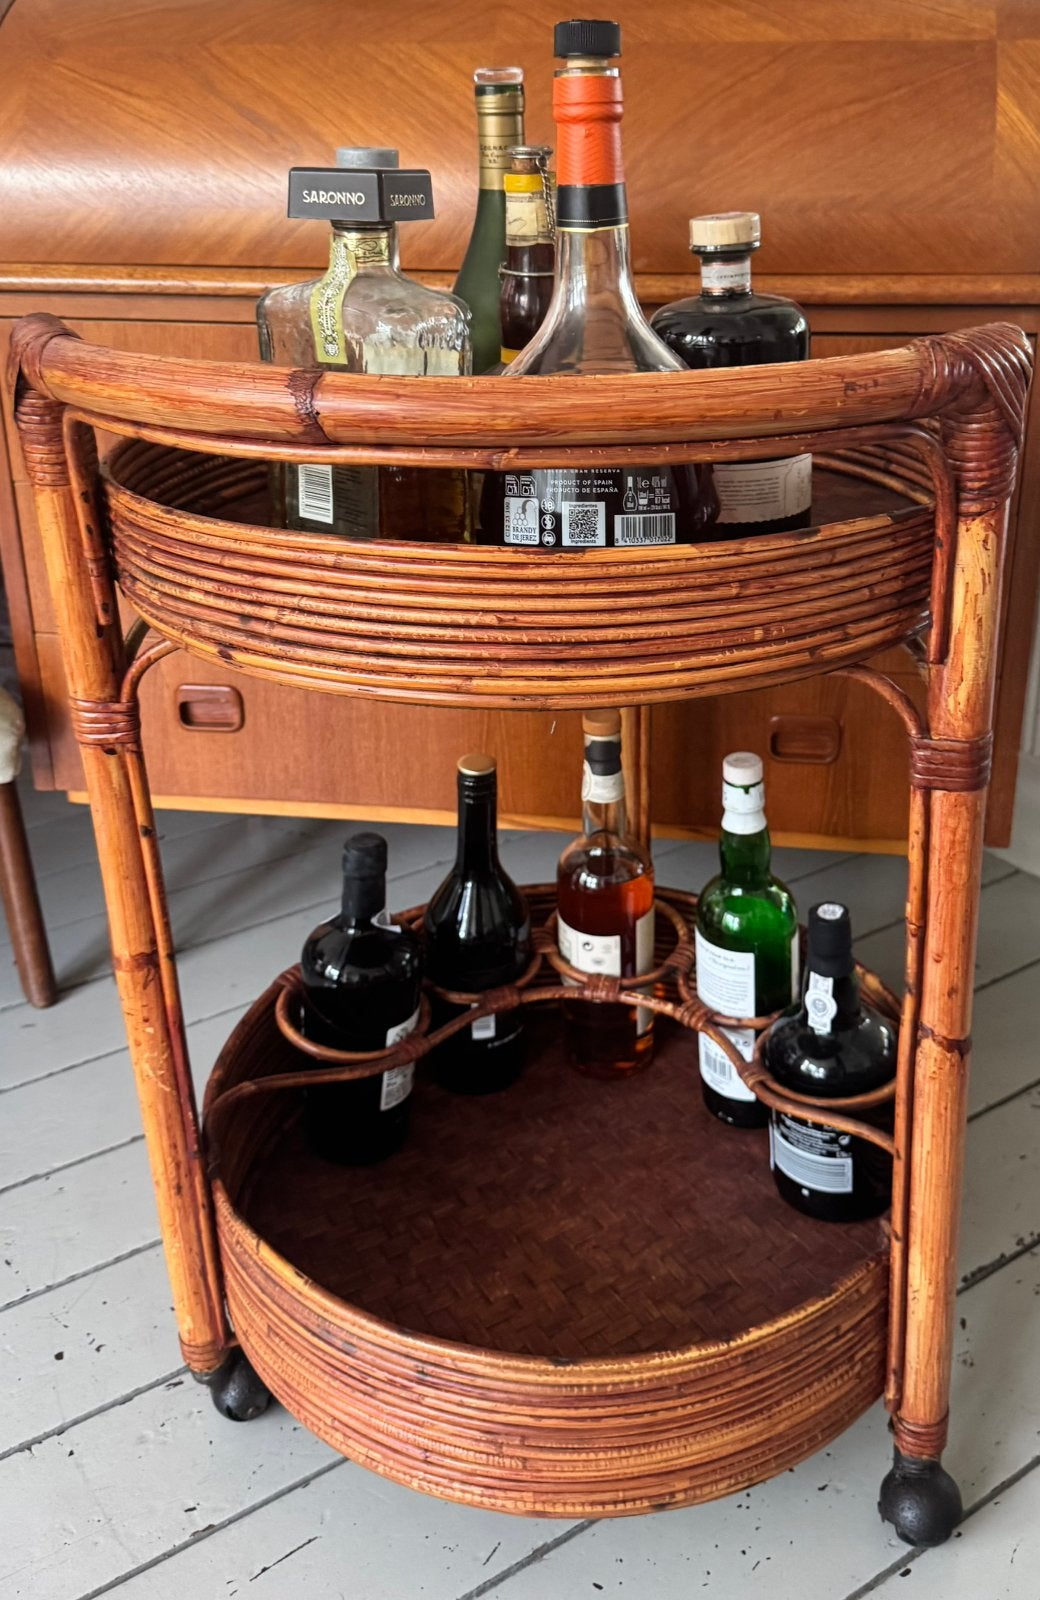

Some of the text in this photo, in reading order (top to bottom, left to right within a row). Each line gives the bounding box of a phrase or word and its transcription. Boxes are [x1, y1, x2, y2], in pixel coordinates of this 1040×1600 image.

[302, 190, 366, 206] SARONNO
[390, 194, 426, 207] SARONNO
[592, 486, 619, 494] ESPAÑA
[512, 526, 537, 534] BRANDY
[512, 533, 537, 542] DE JEREZ
